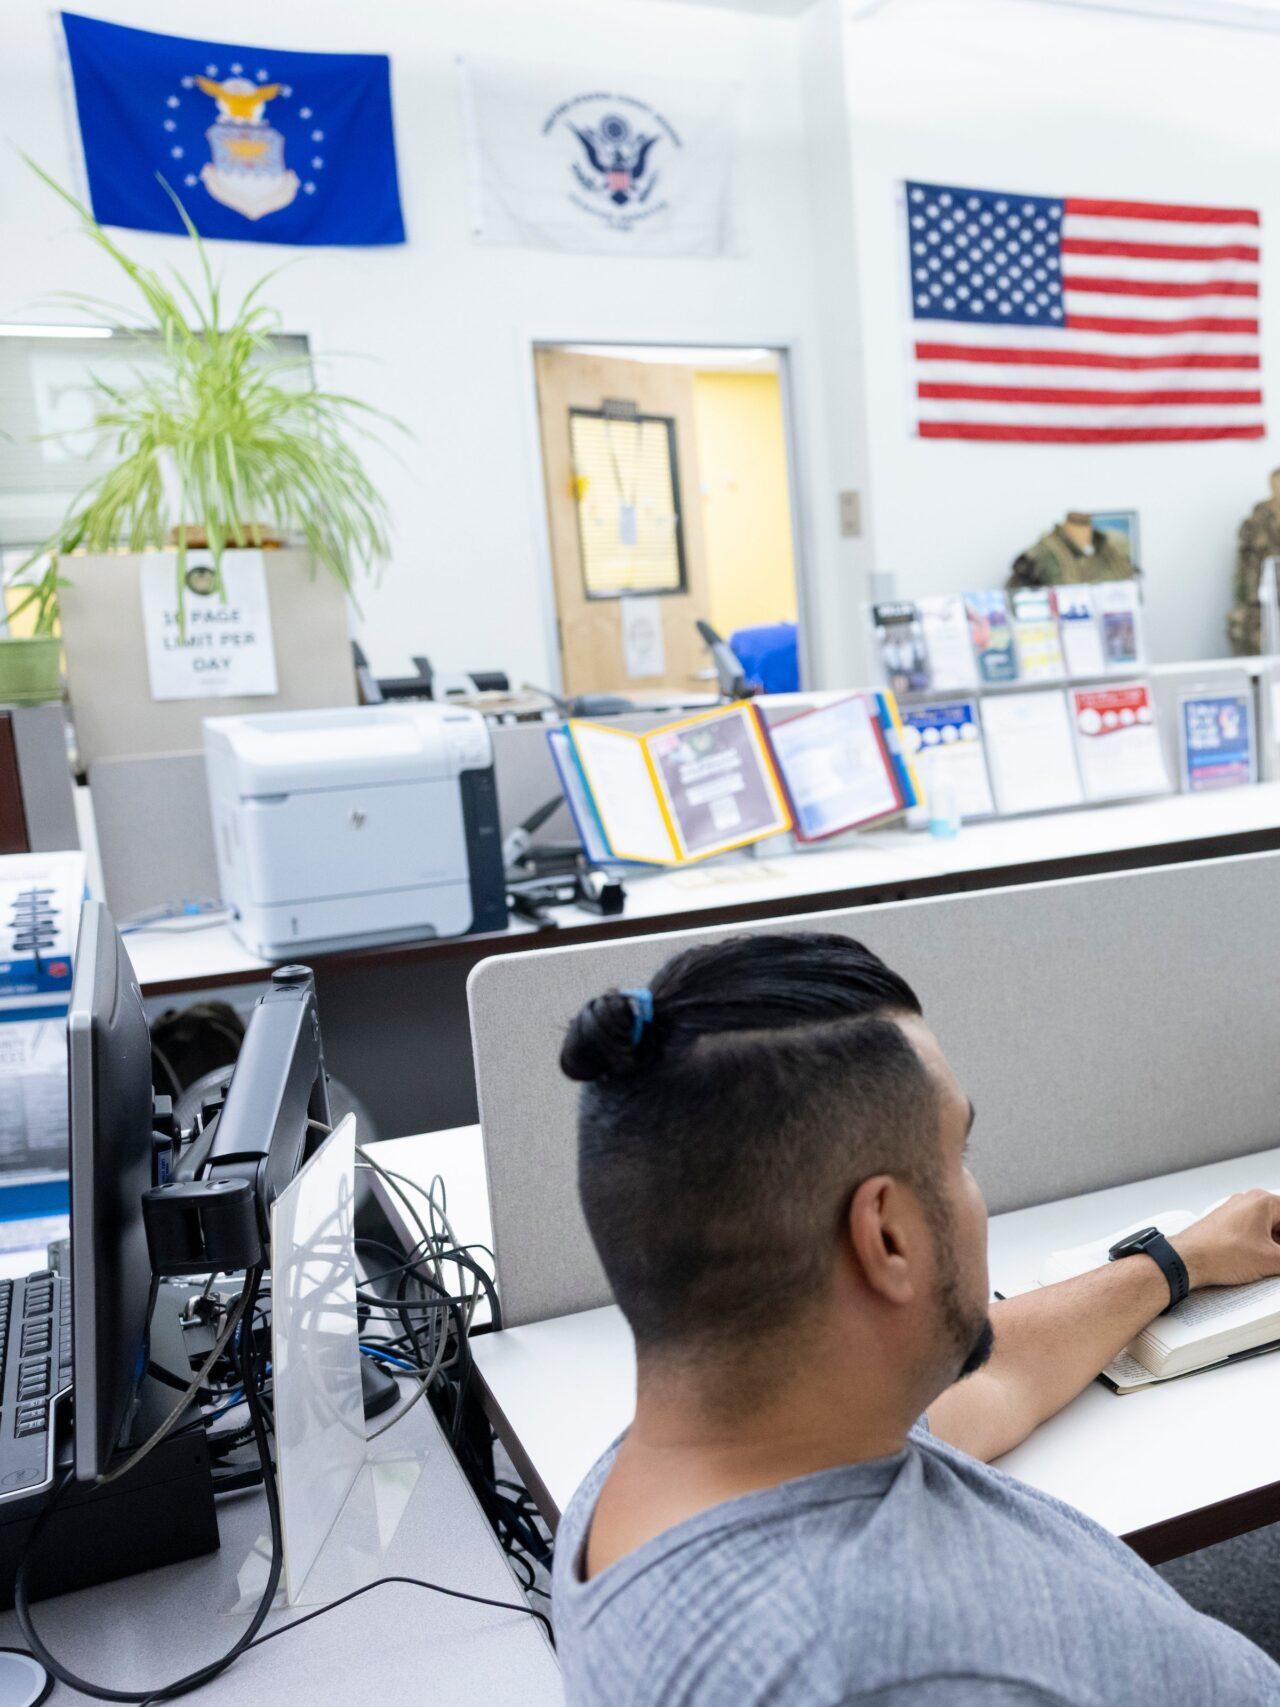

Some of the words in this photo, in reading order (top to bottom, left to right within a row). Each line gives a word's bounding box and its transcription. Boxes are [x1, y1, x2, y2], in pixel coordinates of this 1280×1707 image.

[191, 608, 240, 623] PAGE
[163, 631, 213, 650] LIMIT
[220, 630, 256, 647] PER
[192, 657, 231, 672] DAY
